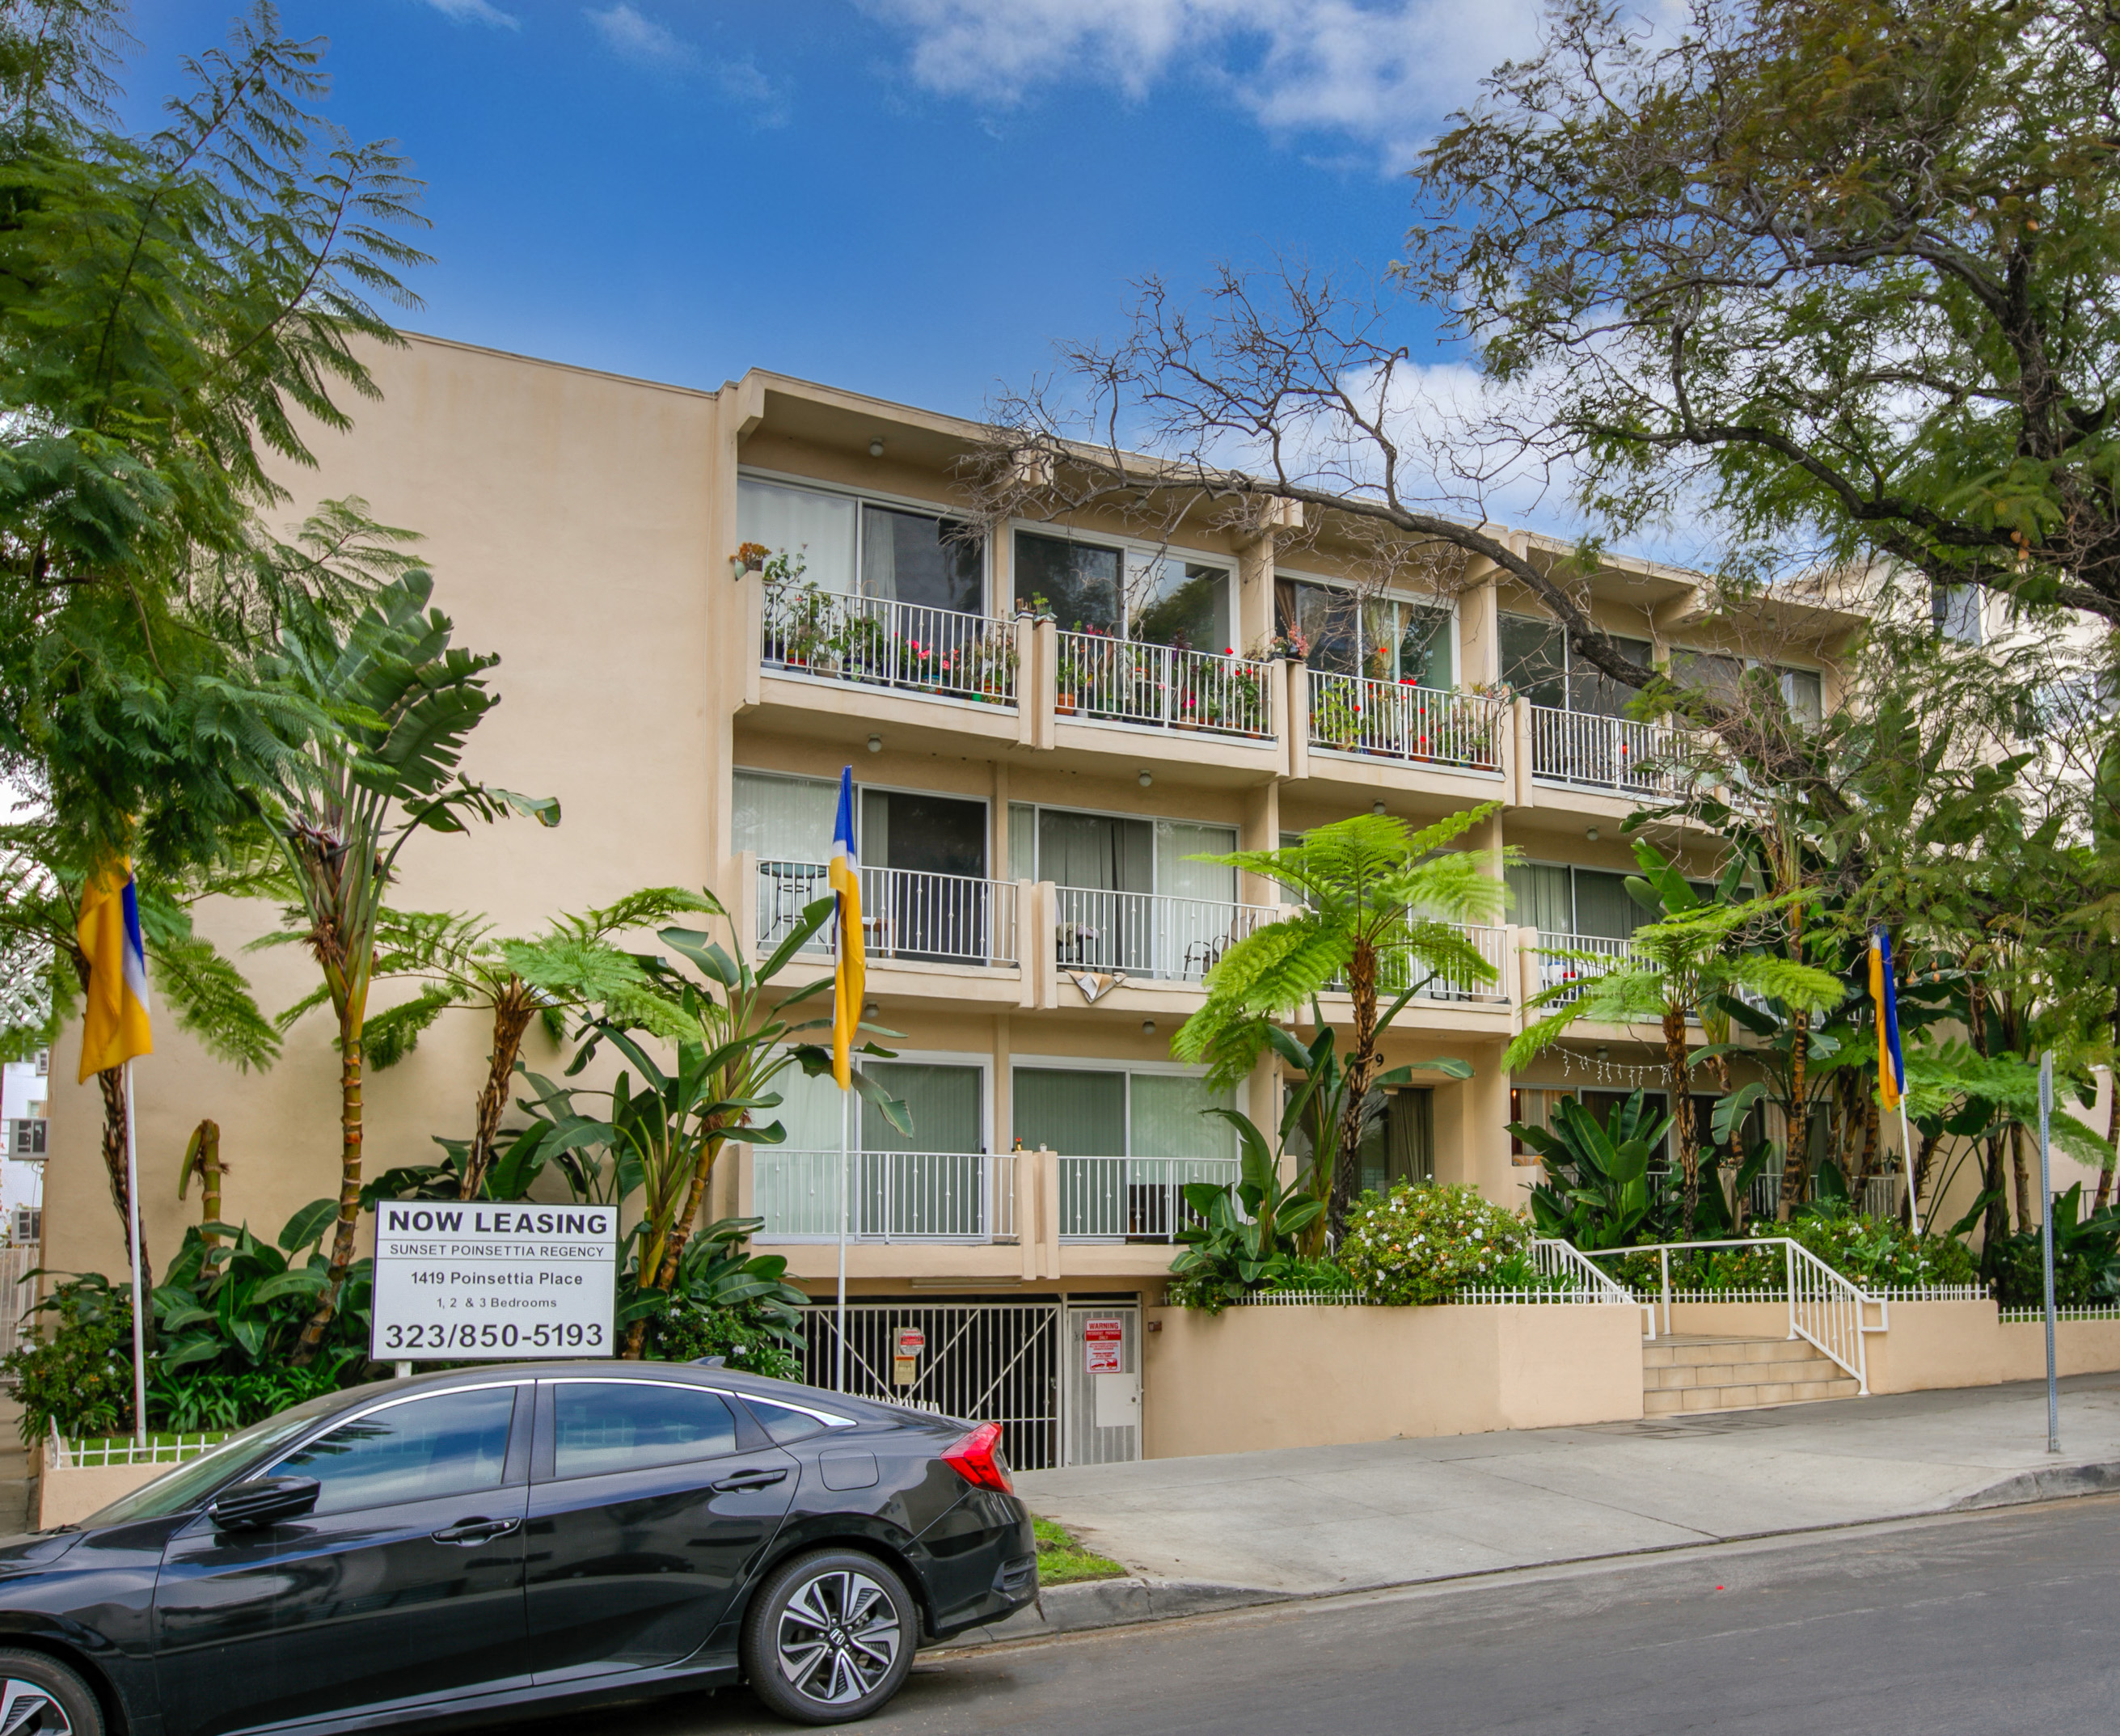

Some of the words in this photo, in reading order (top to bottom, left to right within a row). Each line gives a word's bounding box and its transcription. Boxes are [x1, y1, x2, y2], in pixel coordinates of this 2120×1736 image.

[390, 1211, 463, 1231] NOW
[475, 1213, 607, 1234] LEASING
[390, 1244, 447, 1255] SUNSET
[451, 1245, 535, 1257] POINSETTIA
[540, 1247, 604, 1257] REGENCY
[411, 1272, 445, 1284] 1419
[450, 1272, 534, 1284] Poinsettia
[539, 1273, 583, 1285] Place
[437, 1298, 445, 1309] 1,
[450, 1298, 457, 1307] 2
[465, 1298, 474, 1307] &
[479, 1298, 487, 1307] 3
[491, 1298, 557, 1307] Bedrooms
[386, 1324, 603, 1348] 323/850-5193
